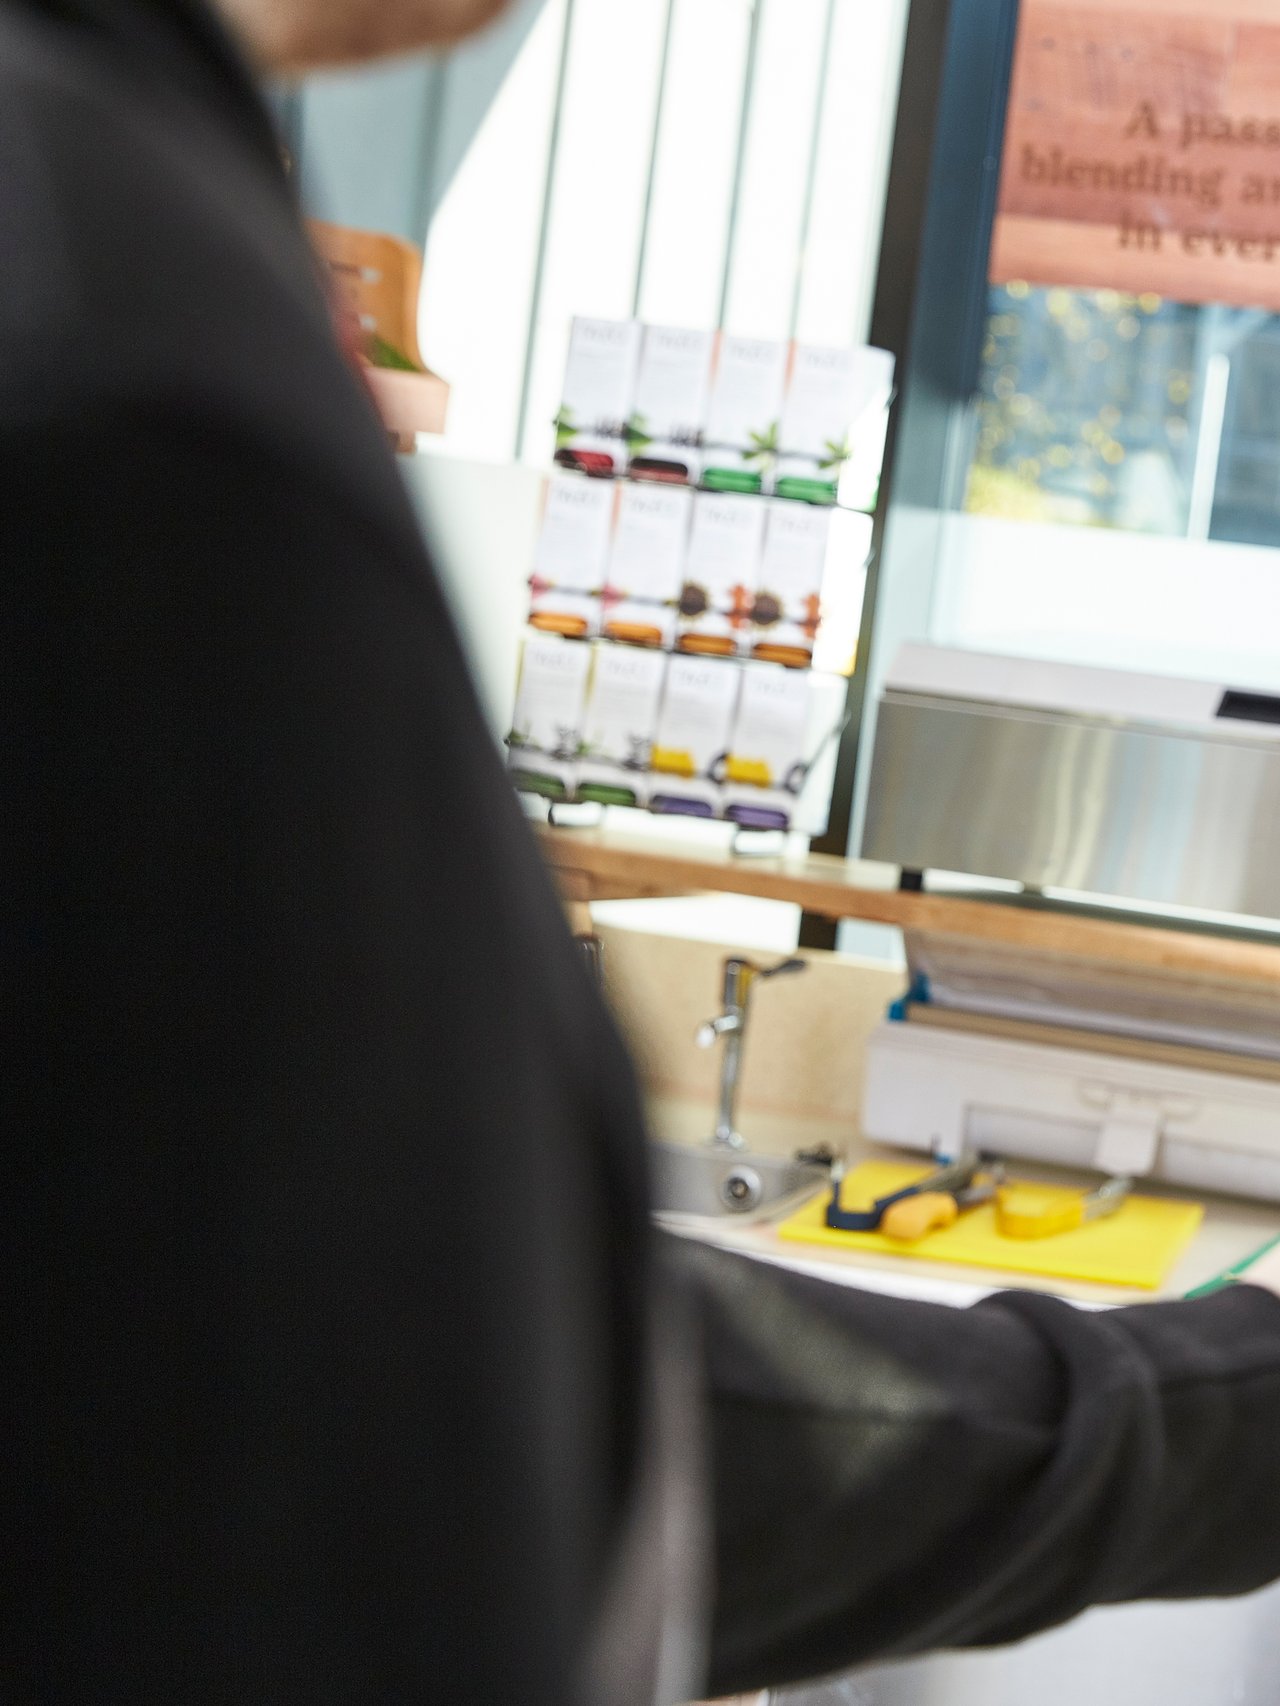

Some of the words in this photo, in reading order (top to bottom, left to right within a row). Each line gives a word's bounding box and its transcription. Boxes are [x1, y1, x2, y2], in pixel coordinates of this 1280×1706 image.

[1125, 101, 1159, 138] A
[1020, 144, 1226, 208] blending
[1116, 210, 1164, 253] in
